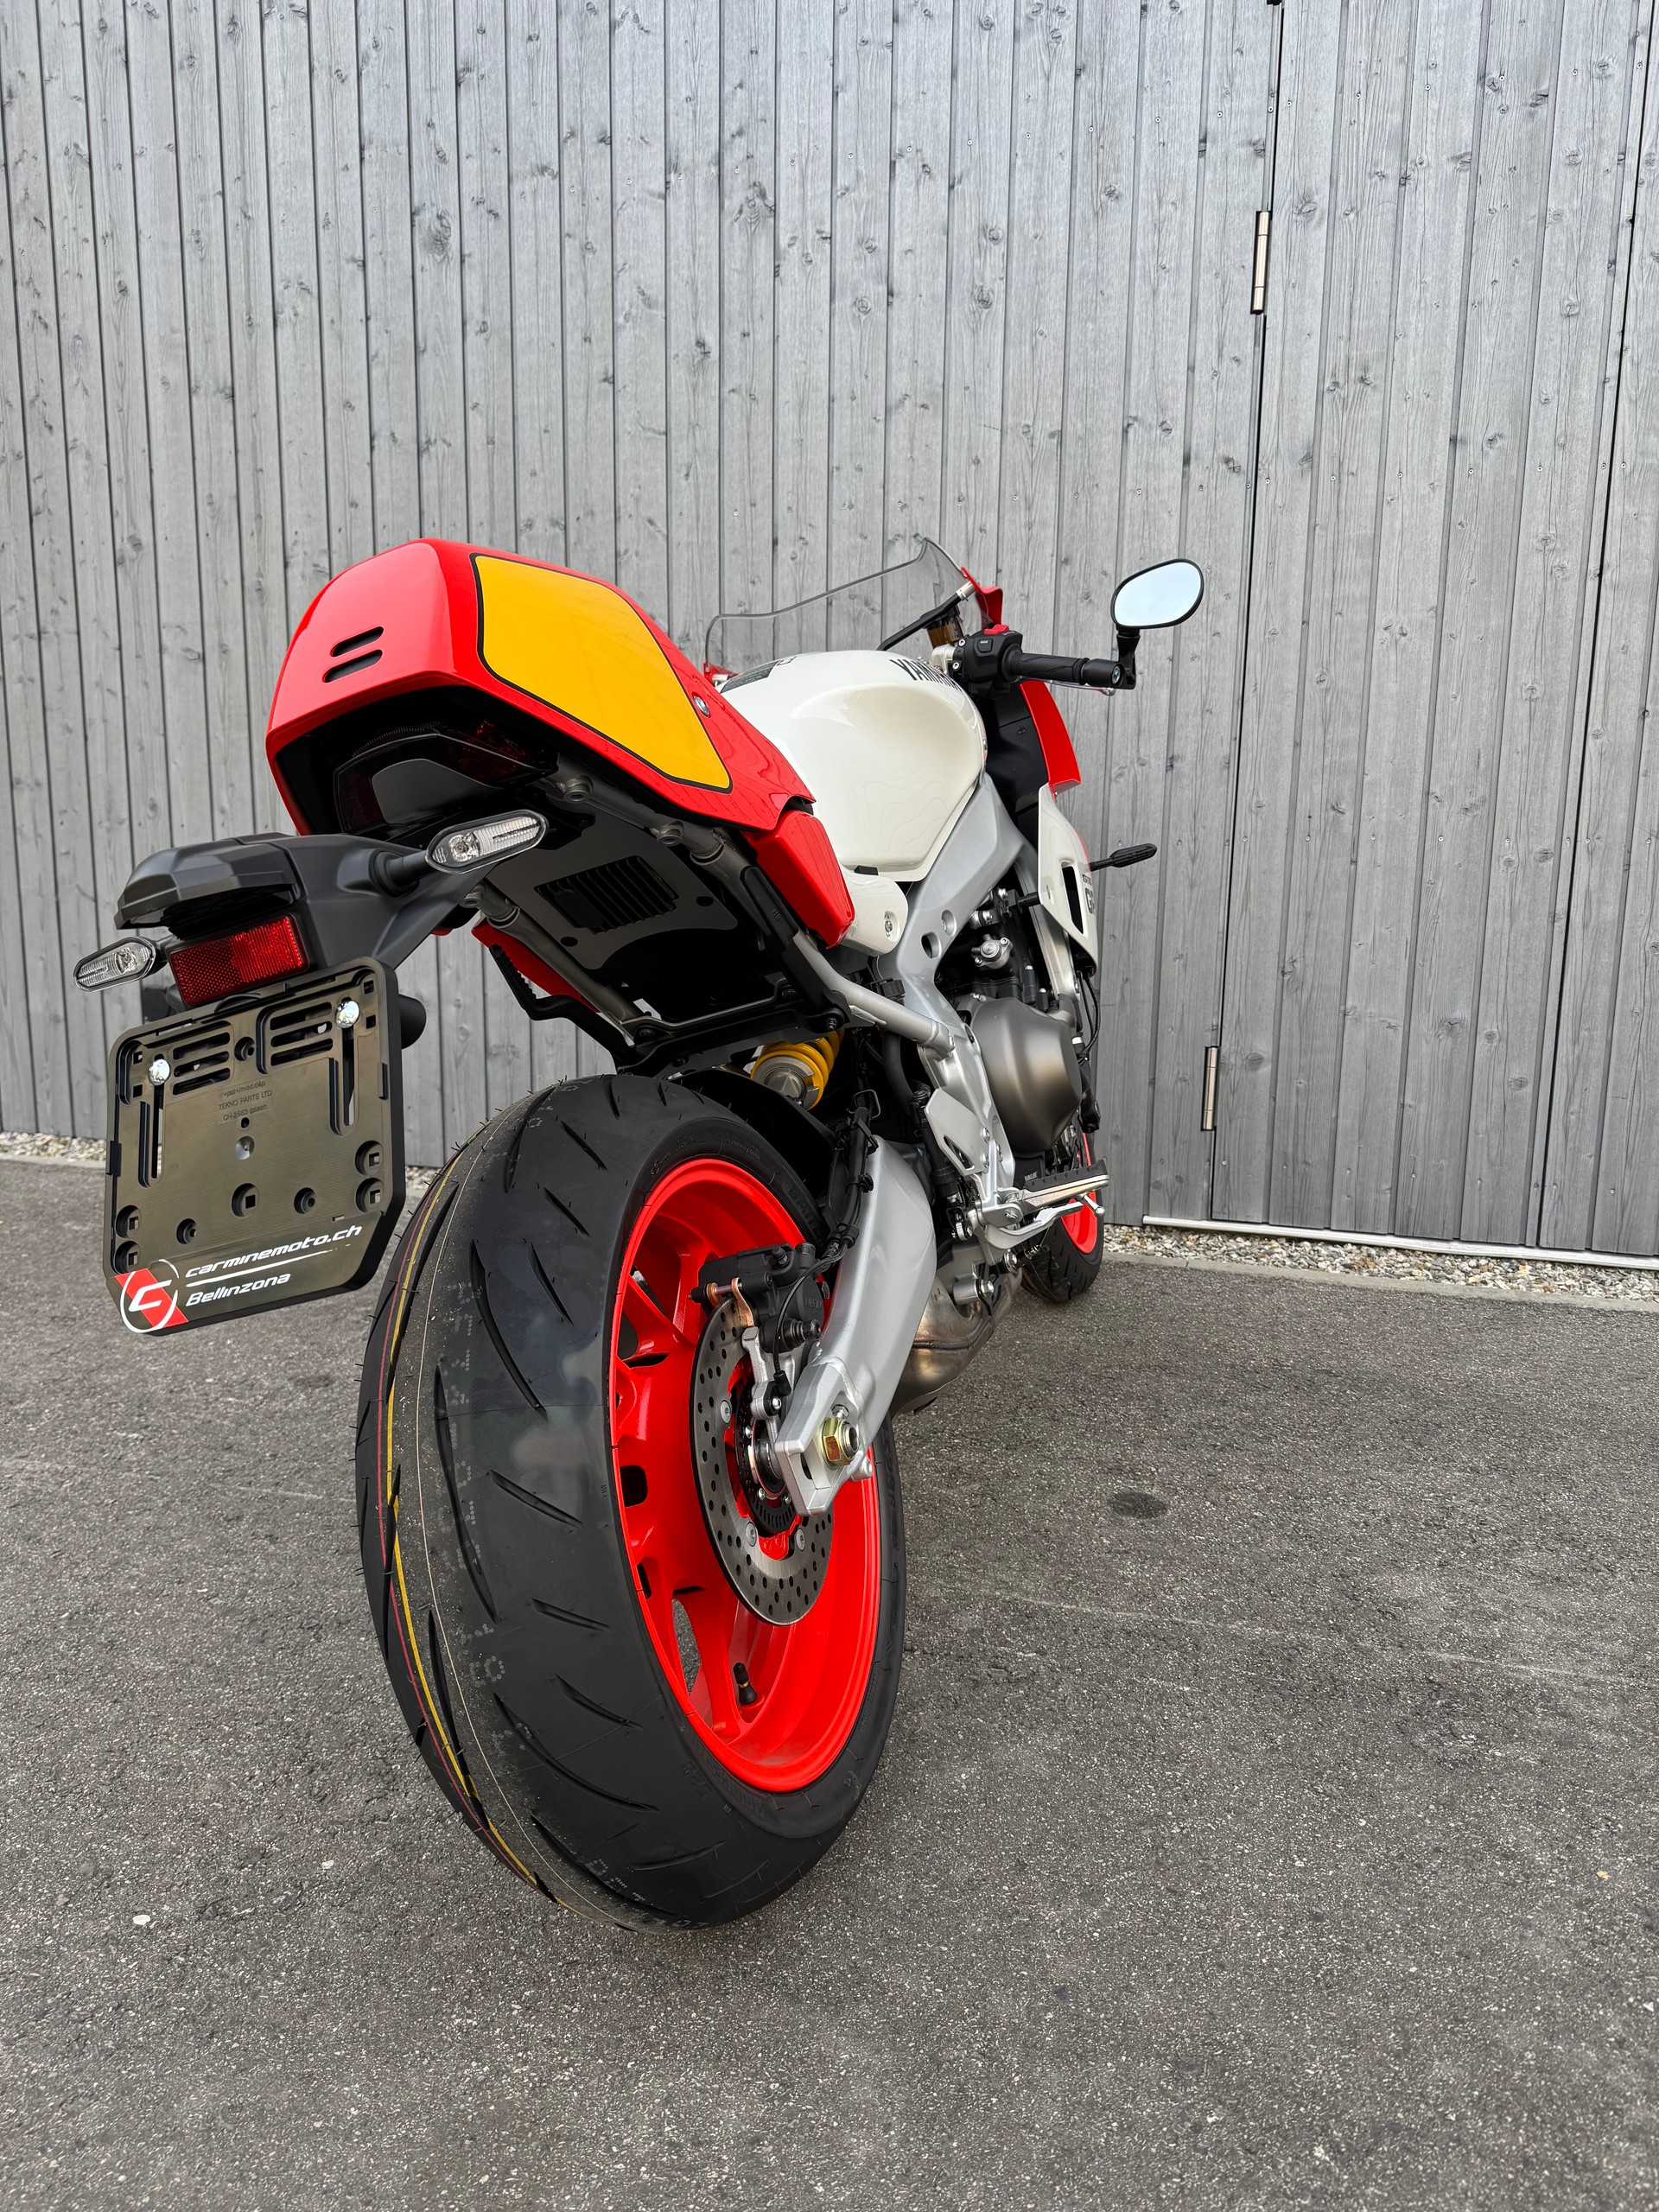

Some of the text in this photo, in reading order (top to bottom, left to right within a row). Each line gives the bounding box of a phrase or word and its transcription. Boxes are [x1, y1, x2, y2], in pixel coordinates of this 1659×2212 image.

[219, 1090, 272, 1110] TEKNO PARTS LTD
[185, 1224, 363, 1279] carminemoto.ch
[185, 1273, 291, 1307] Bellinzona
